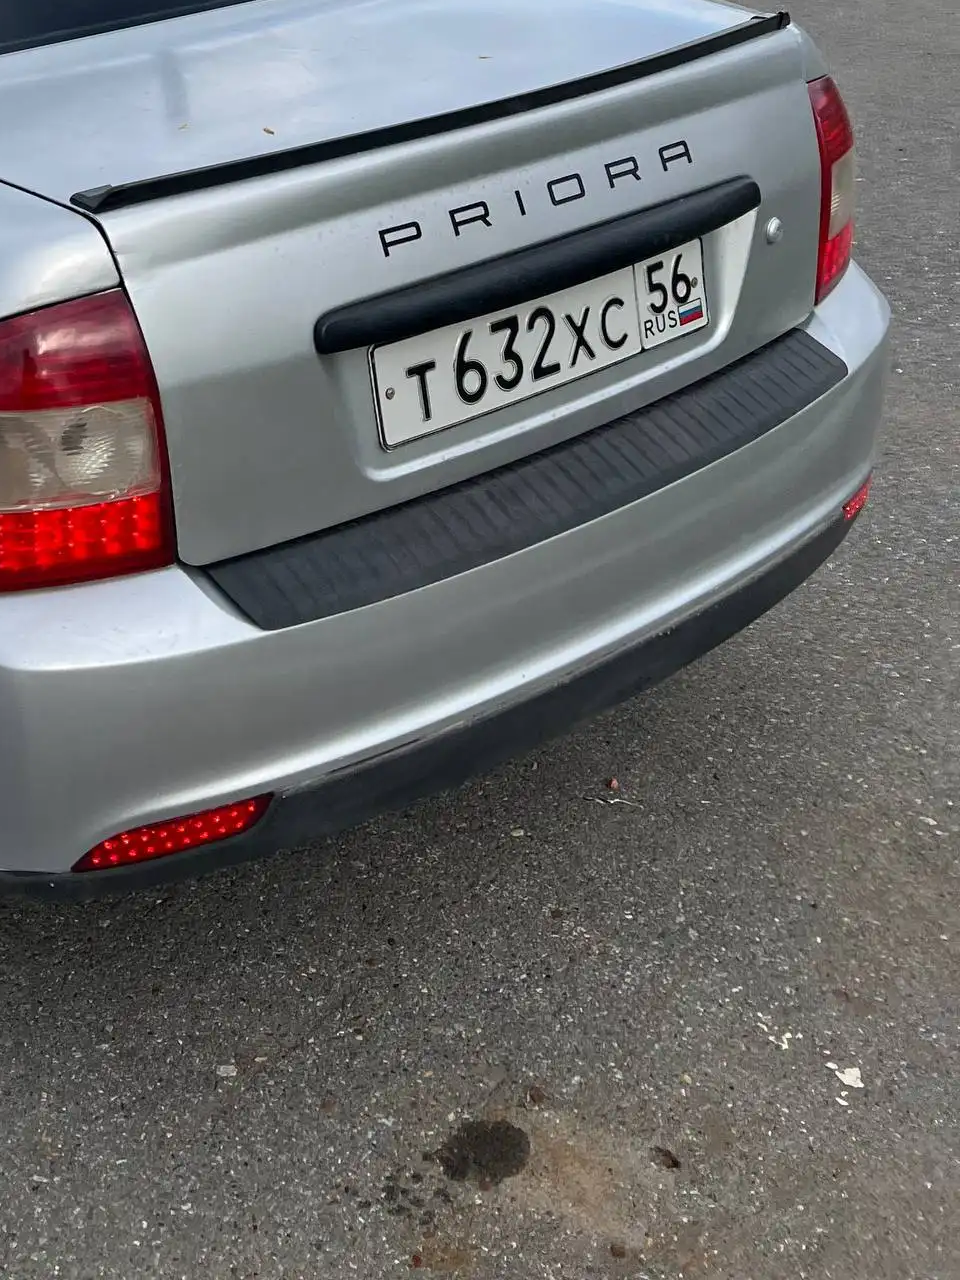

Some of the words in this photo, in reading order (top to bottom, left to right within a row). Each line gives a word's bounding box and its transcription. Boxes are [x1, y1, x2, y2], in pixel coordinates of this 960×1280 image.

[378, 140, 693, 258] PRIORA
[644, 253, 692, 315] 56
[643, 310, 679, 339] RUS
